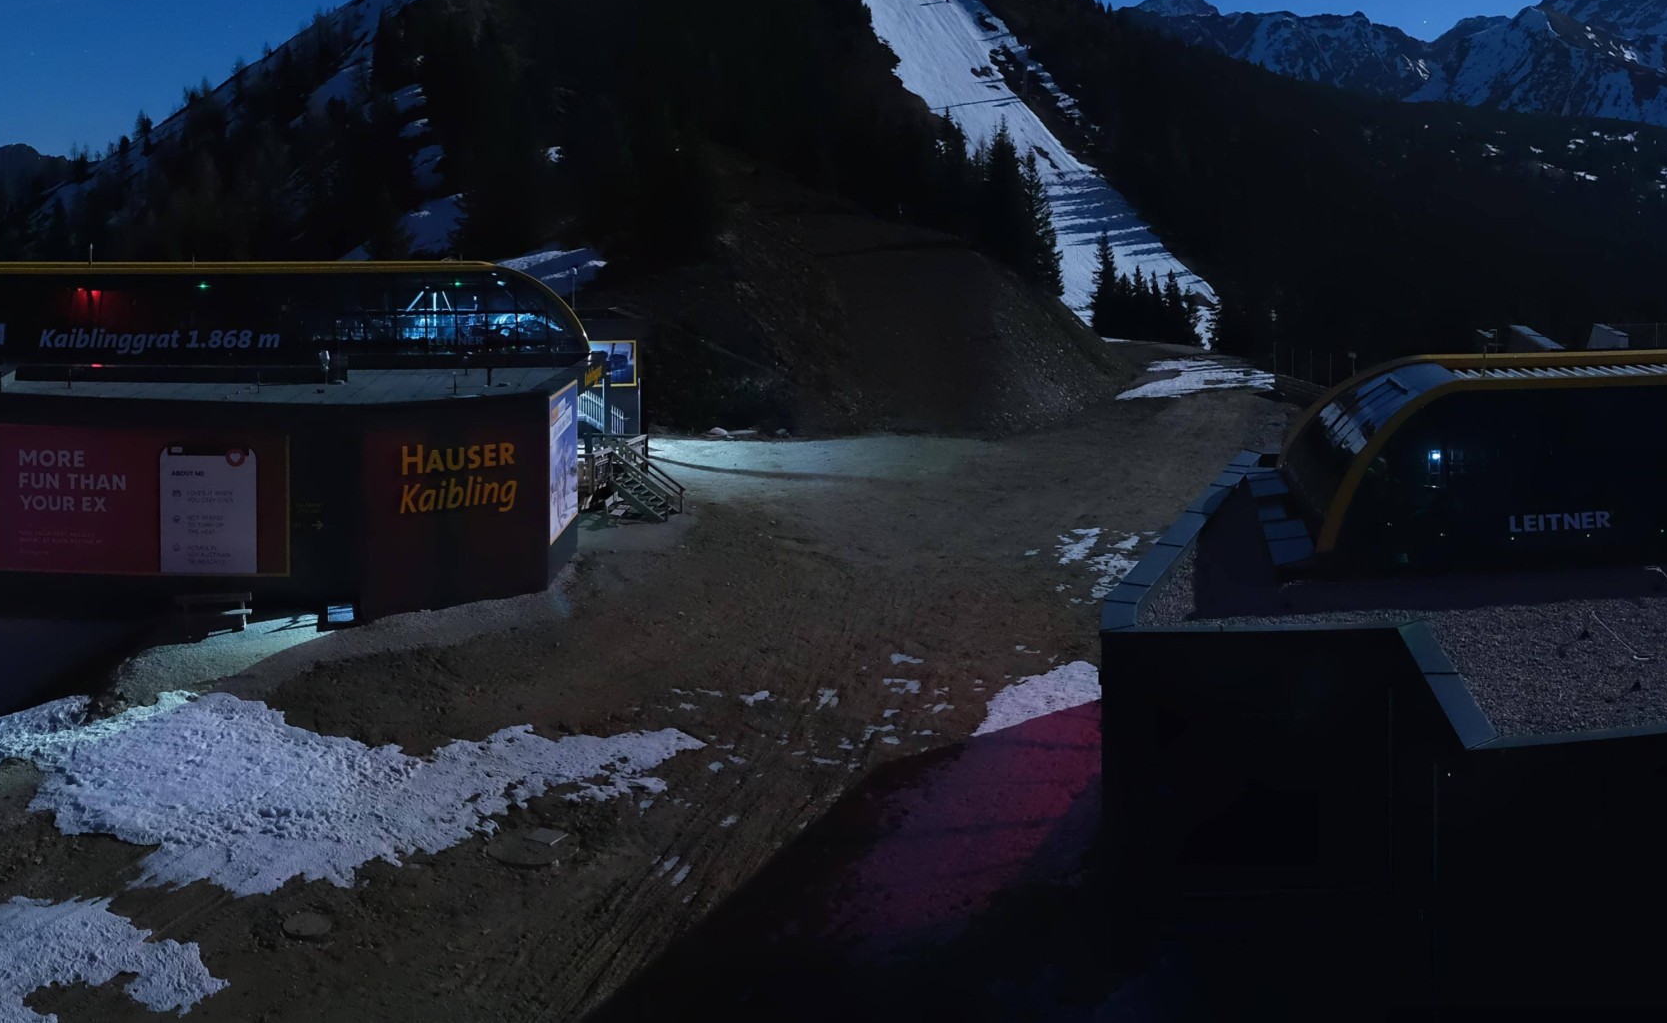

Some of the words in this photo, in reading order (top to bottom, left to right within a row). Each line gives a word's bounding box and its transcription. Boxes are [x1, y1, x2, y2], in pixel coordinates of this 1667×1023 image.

[39, 327, 180, 354] Kaiblinggrat
[186, 329, 253, 349] 1.868
[257, 333, 280, 349] m
[428, 336, 484, 346] LEITNER
[18, 448, 85, 467] MORE
[18, 472, 60, 489] FUN
[67, 473, 127, 491] THAN
[19, 495, 75, 511] YOUR
[81, 496, 107, 512] EX
[399, 475, 518, 514] Kaibling
[1508, 510, 1612, 533] LEITNER
